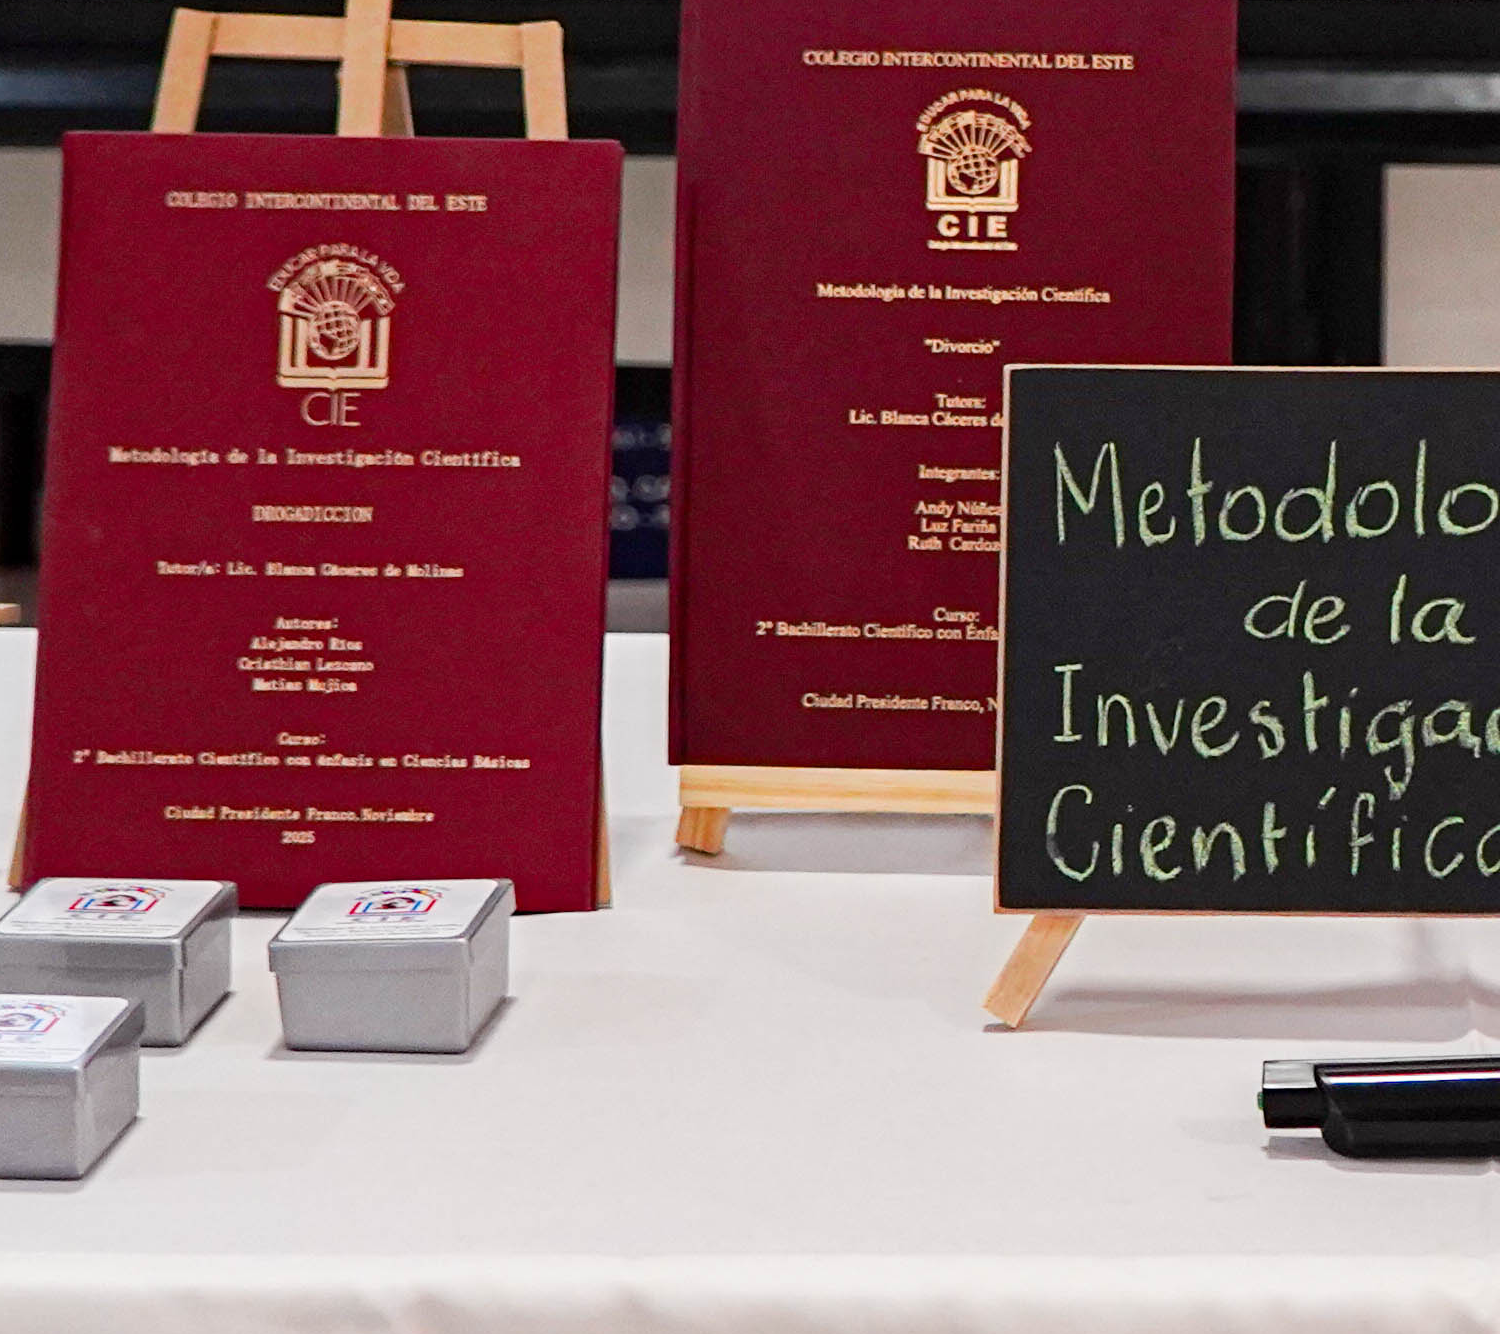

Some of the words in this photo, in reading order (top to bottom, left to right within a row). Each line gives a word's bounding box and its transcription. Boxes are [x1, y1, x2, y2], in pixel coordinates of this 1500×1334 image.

[802, 50, 881, 65] COLEGIO
[881, 51, 1053, 67] INTERCONTINENTAL
[1054, 54, 1090, 68] DEL
[1088, 54, 1135, 69] ESTE
[165, 191, 239, 208] COLEGIO
[406, 194, 440, 211] DEL
[444, 195, 488, 212] ESTE
[936, 214, 1008, 236] CIE
[907, 285, 927, 298] de
[927, 285, 943, 298] la
[300, 392, 361, 426] CIE
[848, 409, 878, 423] Lic.
[880, 411, 930, 424] Blanca
[990, 412, 1002, 428] d
[226, 448, 249, 463] de
[257, 448, 278, 464] la
[920, 518, 949, 531] Luz
[1243, 579, 1351, 643] de
[1389, 573, 1477, 645] la
